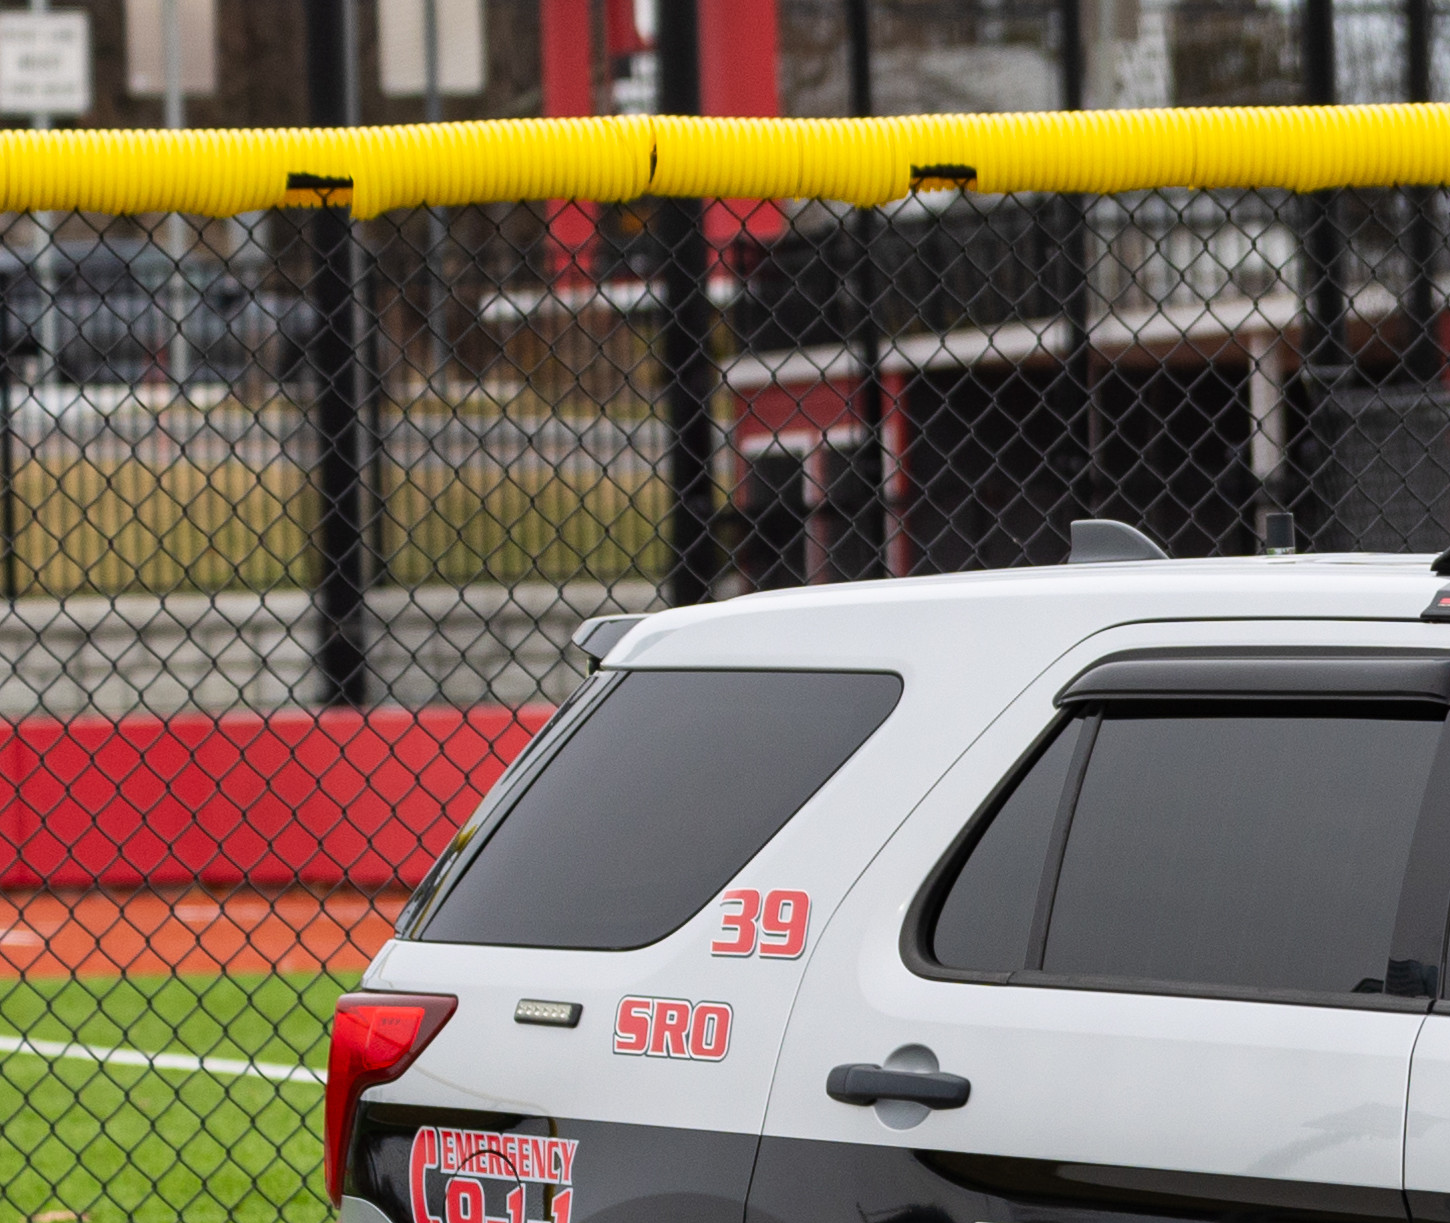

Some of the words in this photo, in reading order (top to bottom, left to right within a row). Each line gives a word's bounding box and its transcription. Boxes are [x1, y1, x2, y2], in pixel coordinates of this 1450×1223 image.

[711, 888, 812, 960] 39
[613, 994, 733, 1062] SRO
[440, 1128, 579, 1186] EMERGENCY
